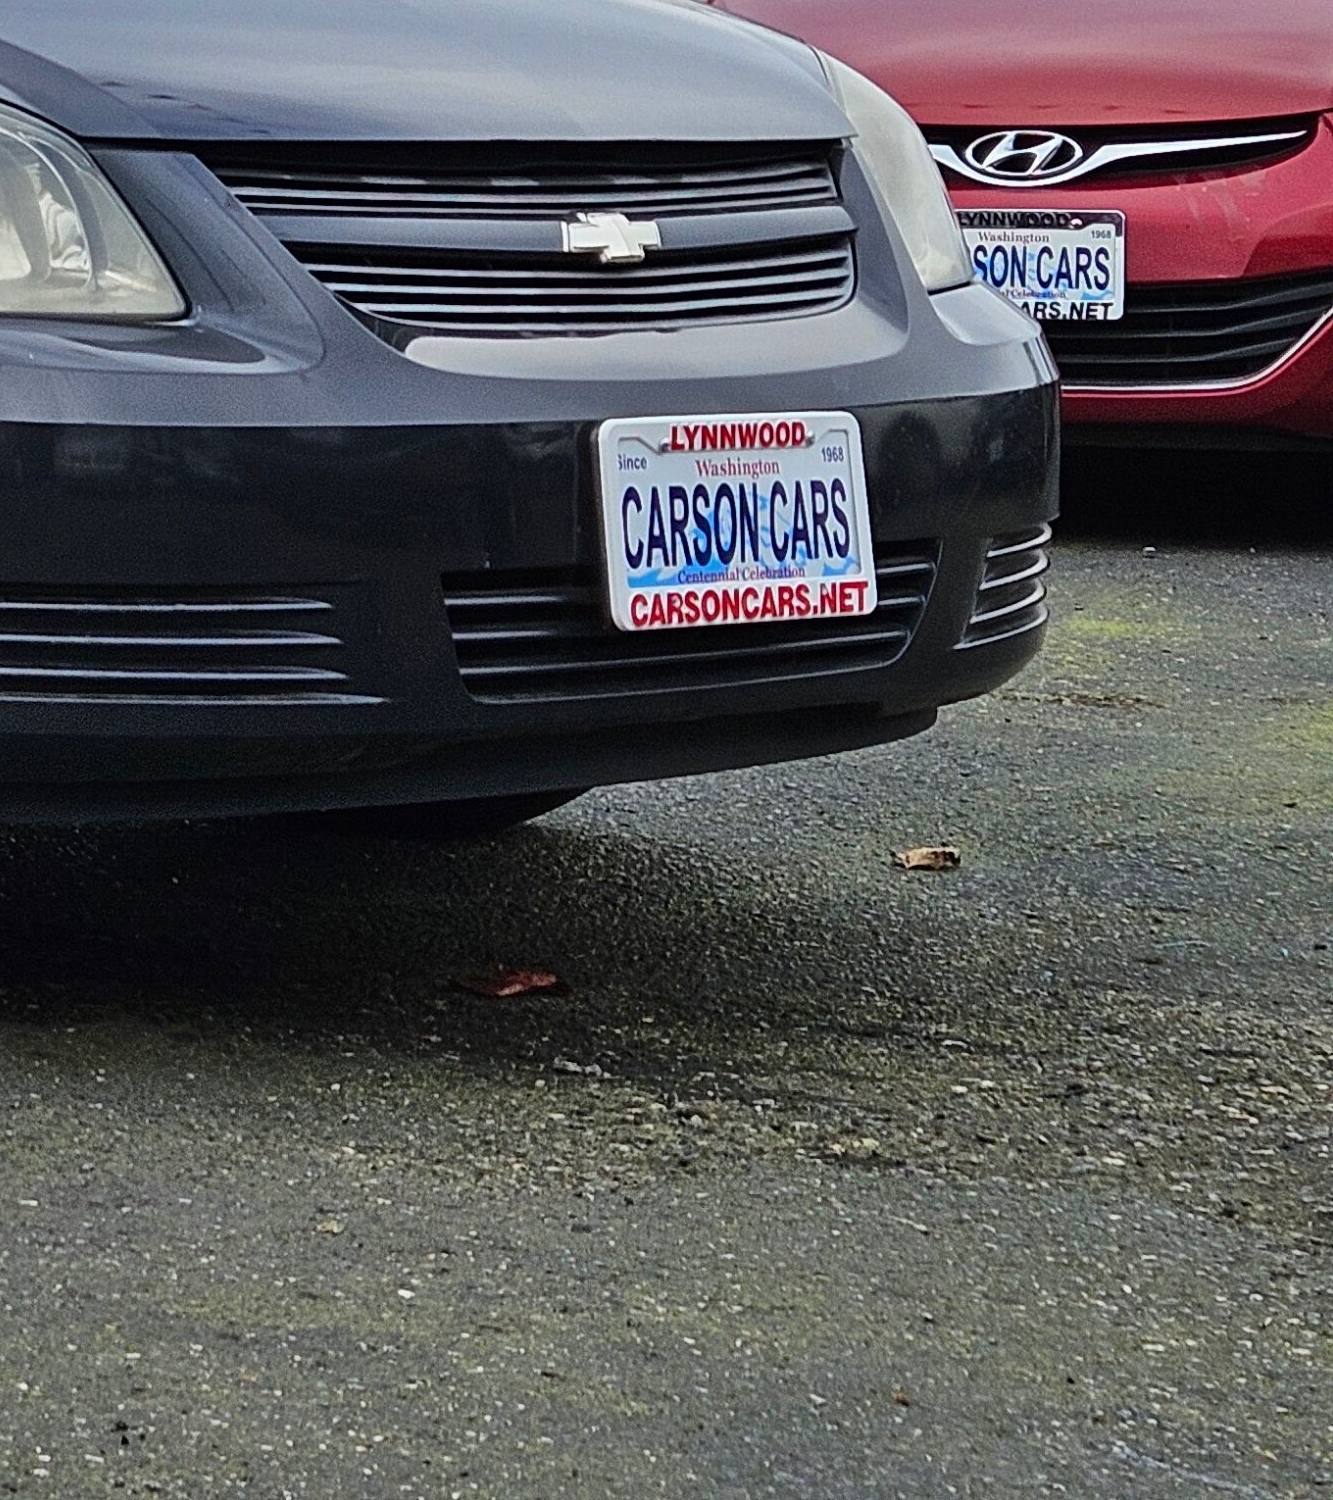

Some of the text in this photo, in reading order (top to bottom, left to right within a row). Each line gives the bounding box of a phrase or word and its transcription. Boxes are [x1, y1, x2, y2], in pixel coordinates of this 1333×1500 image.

[977, 231, 1050, 245] Washington
[1090, 229, 1112, 240] 1968
[972, 244, 1111, 291] SON CARS
[670, 420, 807, 452] LYNNWOOD
[821, 446, 844, 462] 1968
[695, 456, 780, 480] Washington
[621, 477, 851, 569] CARSON CARS
[677, 566, 806, 585] Centennial Celebration
[630, 580, 869, 627] CARSONCARS.NET
